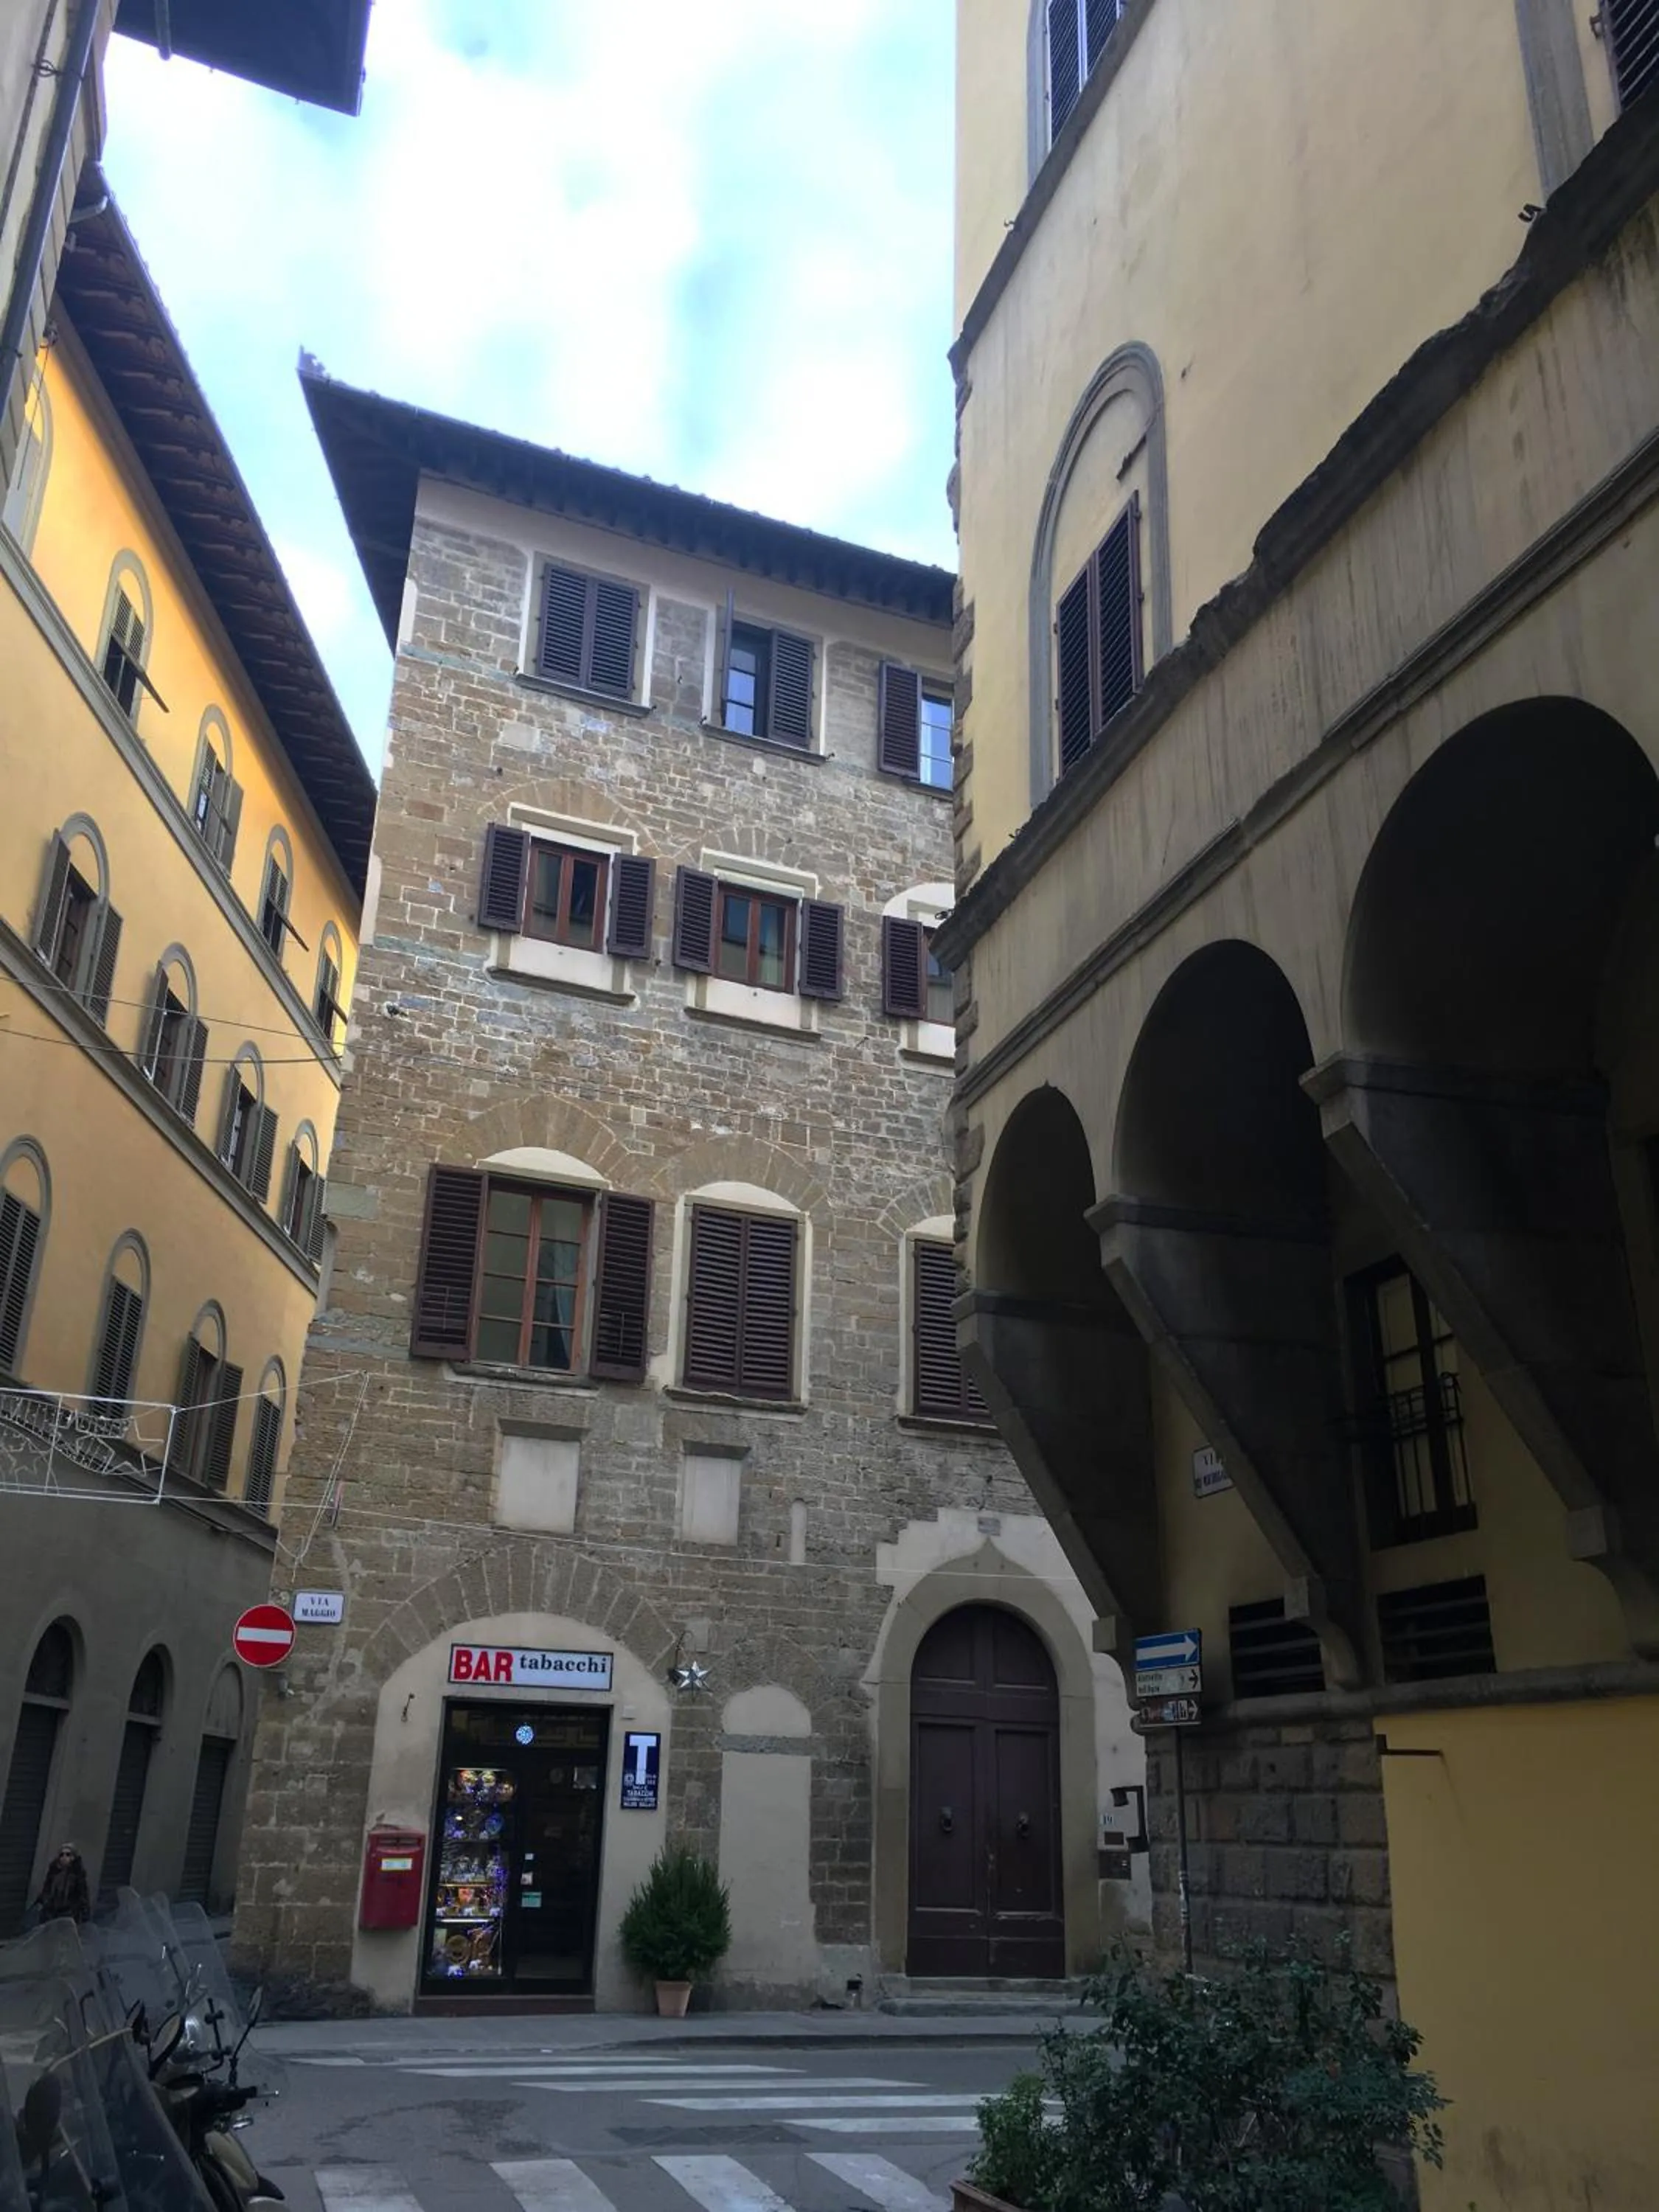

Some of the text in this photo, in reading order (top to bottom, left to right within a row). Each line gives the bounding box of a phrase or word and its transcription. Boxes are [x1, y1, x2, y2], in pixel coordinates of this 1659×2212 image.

[310, 1596, 329, 1606] VIA
[453, 1649, 607, 1683] BAR tabacchi
[630, 1735, 657, 1785] T
